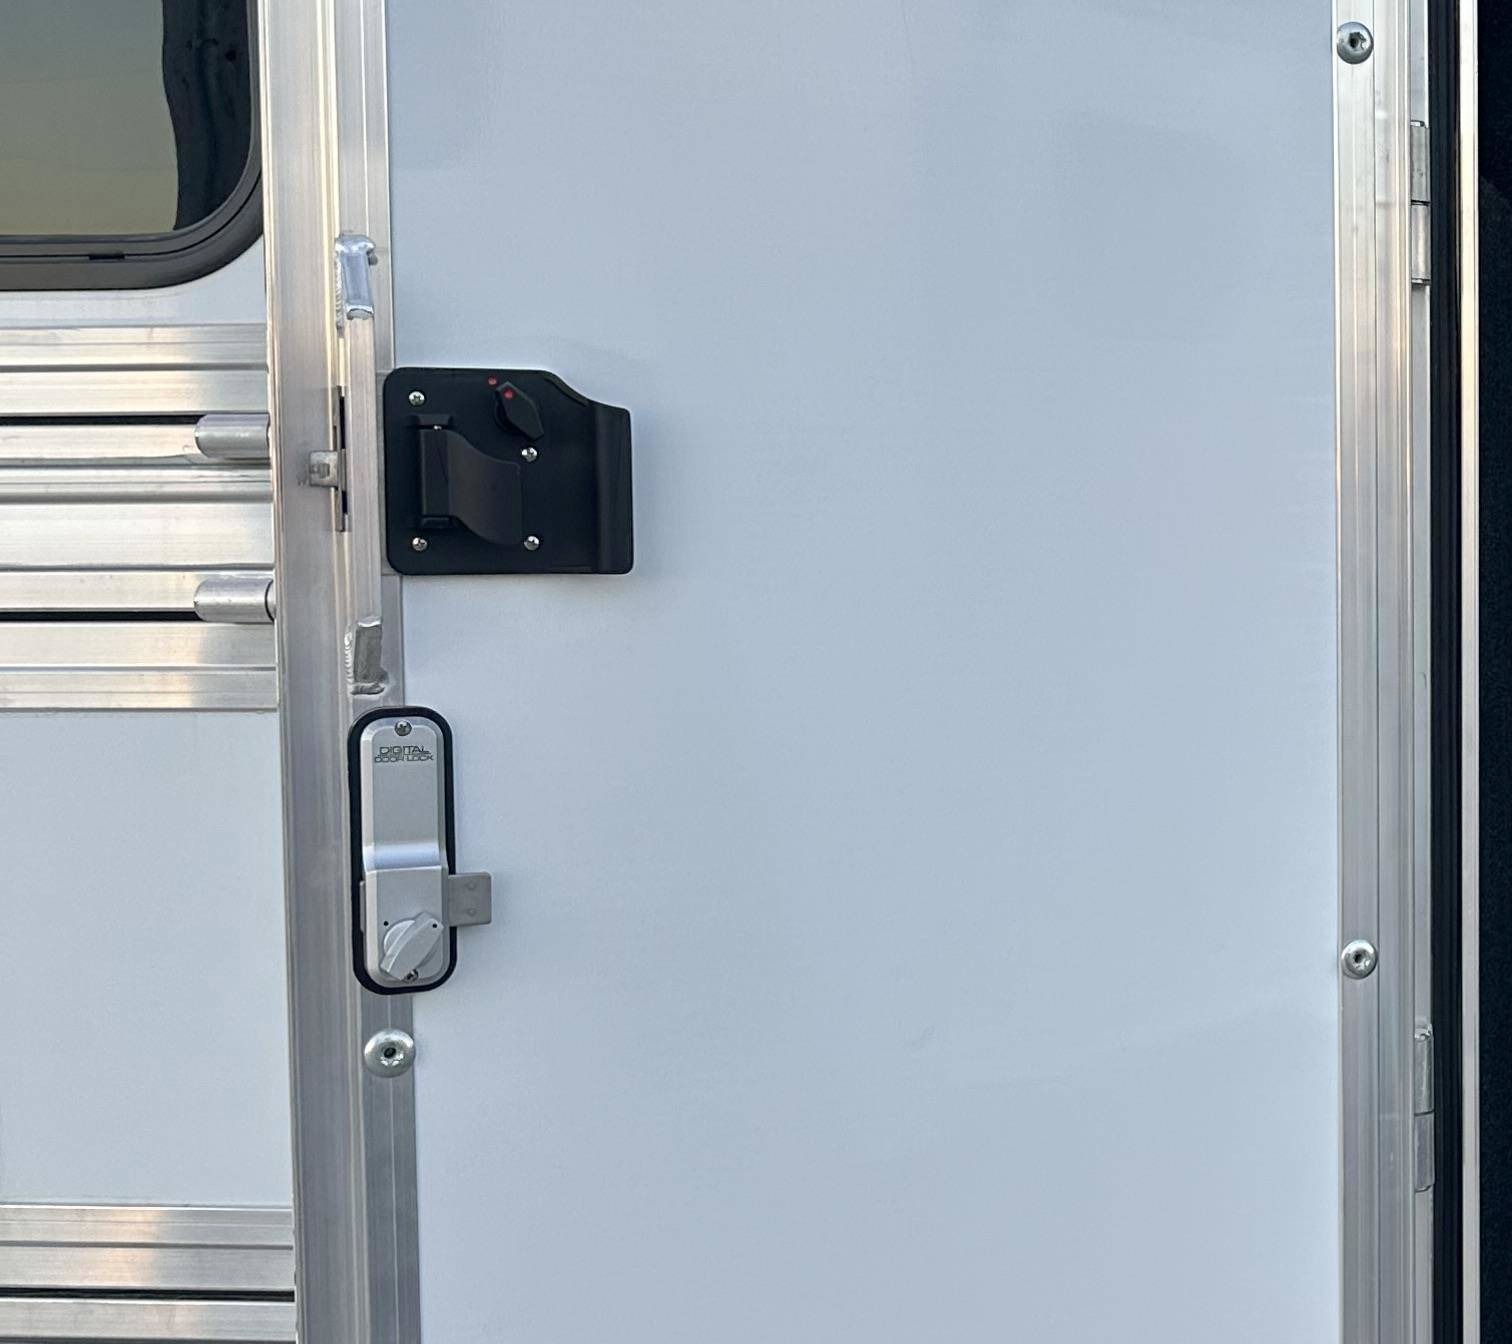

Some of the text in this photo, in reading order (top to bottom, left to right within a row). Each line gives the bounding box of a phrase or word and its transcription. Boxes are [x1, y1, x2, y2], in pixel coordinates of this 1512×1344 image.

[379, 745, 432, 755] DIGITAL
[374, 754, 434, 763] DOOR LOCK
